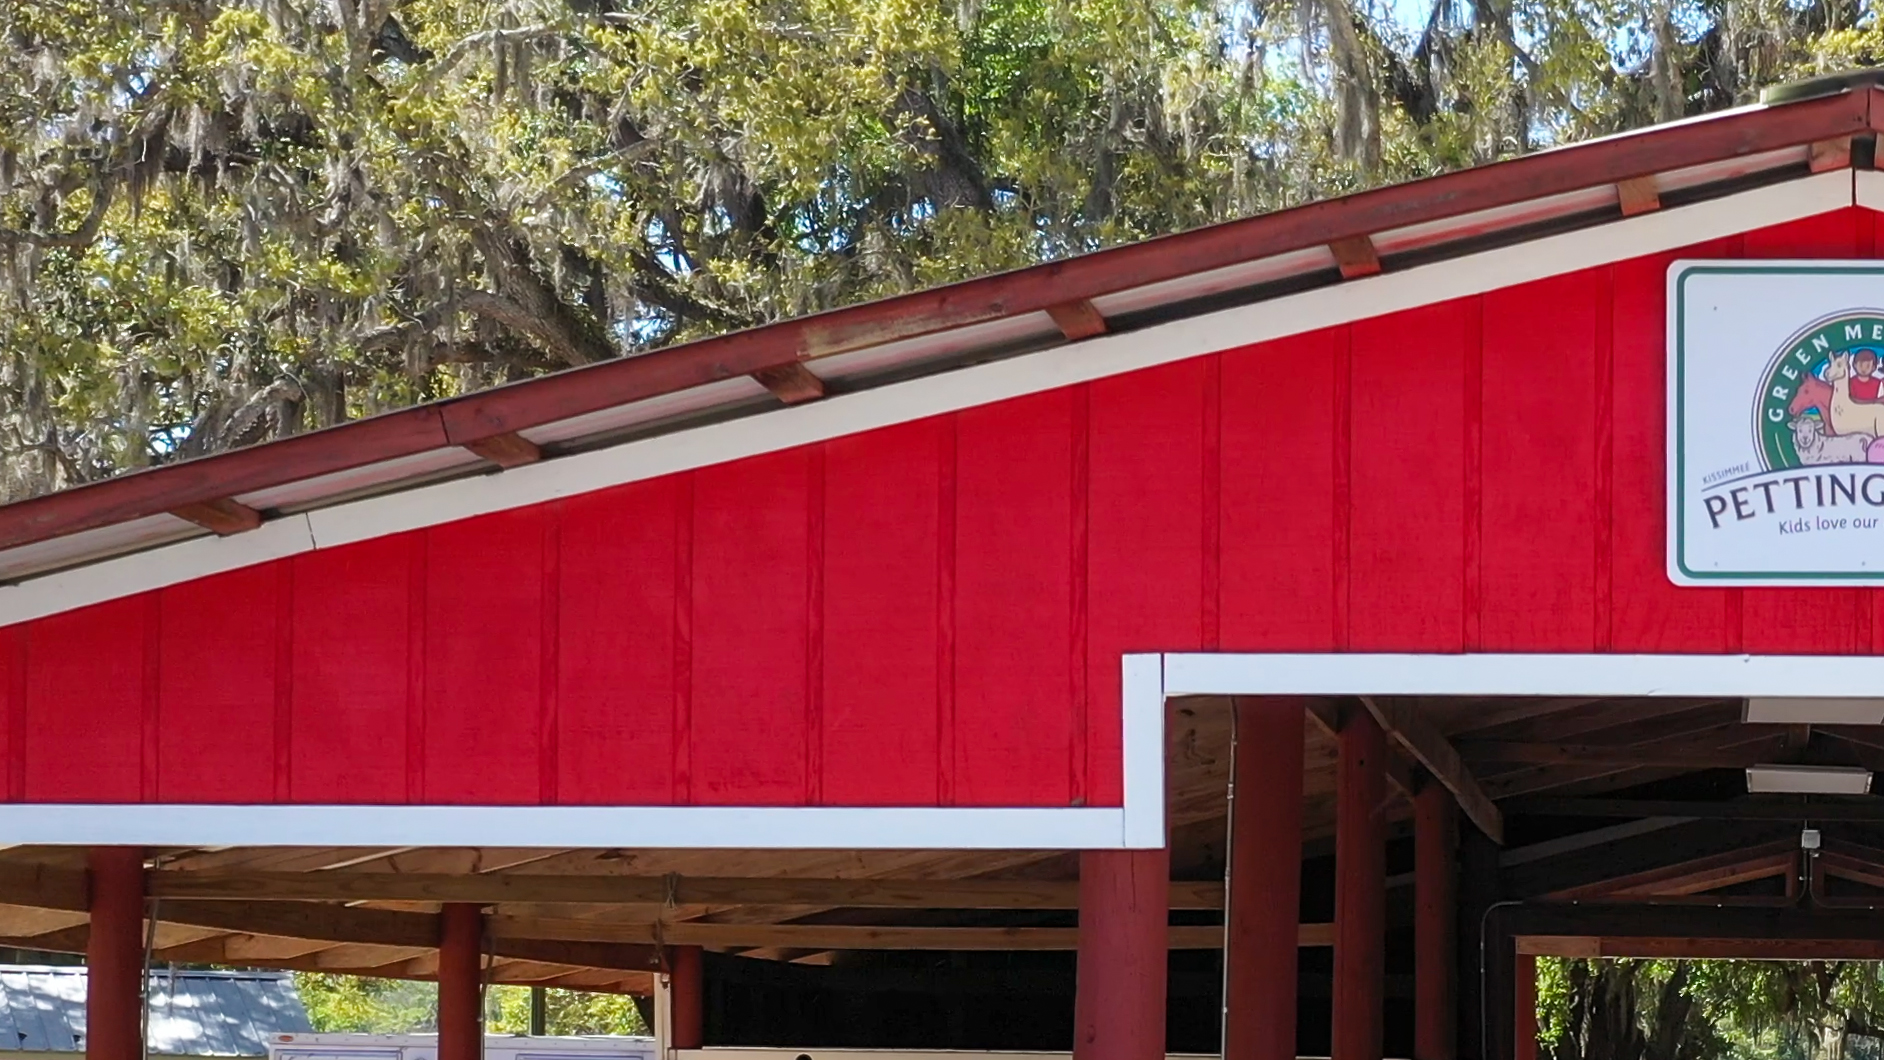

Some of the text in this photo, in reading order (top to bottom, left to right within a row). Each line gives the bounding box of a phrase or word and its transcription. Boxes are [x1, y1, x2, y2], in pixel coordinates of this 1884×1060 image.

[1768, 334, 1829, 422] GREEN
[1702, 461, 1751, 485] KISSIMMEE
[1779, 517, 1811, 536] Kids
[1816, 515, 1847, 531] love
[1853, 517, 1879, 529] our
